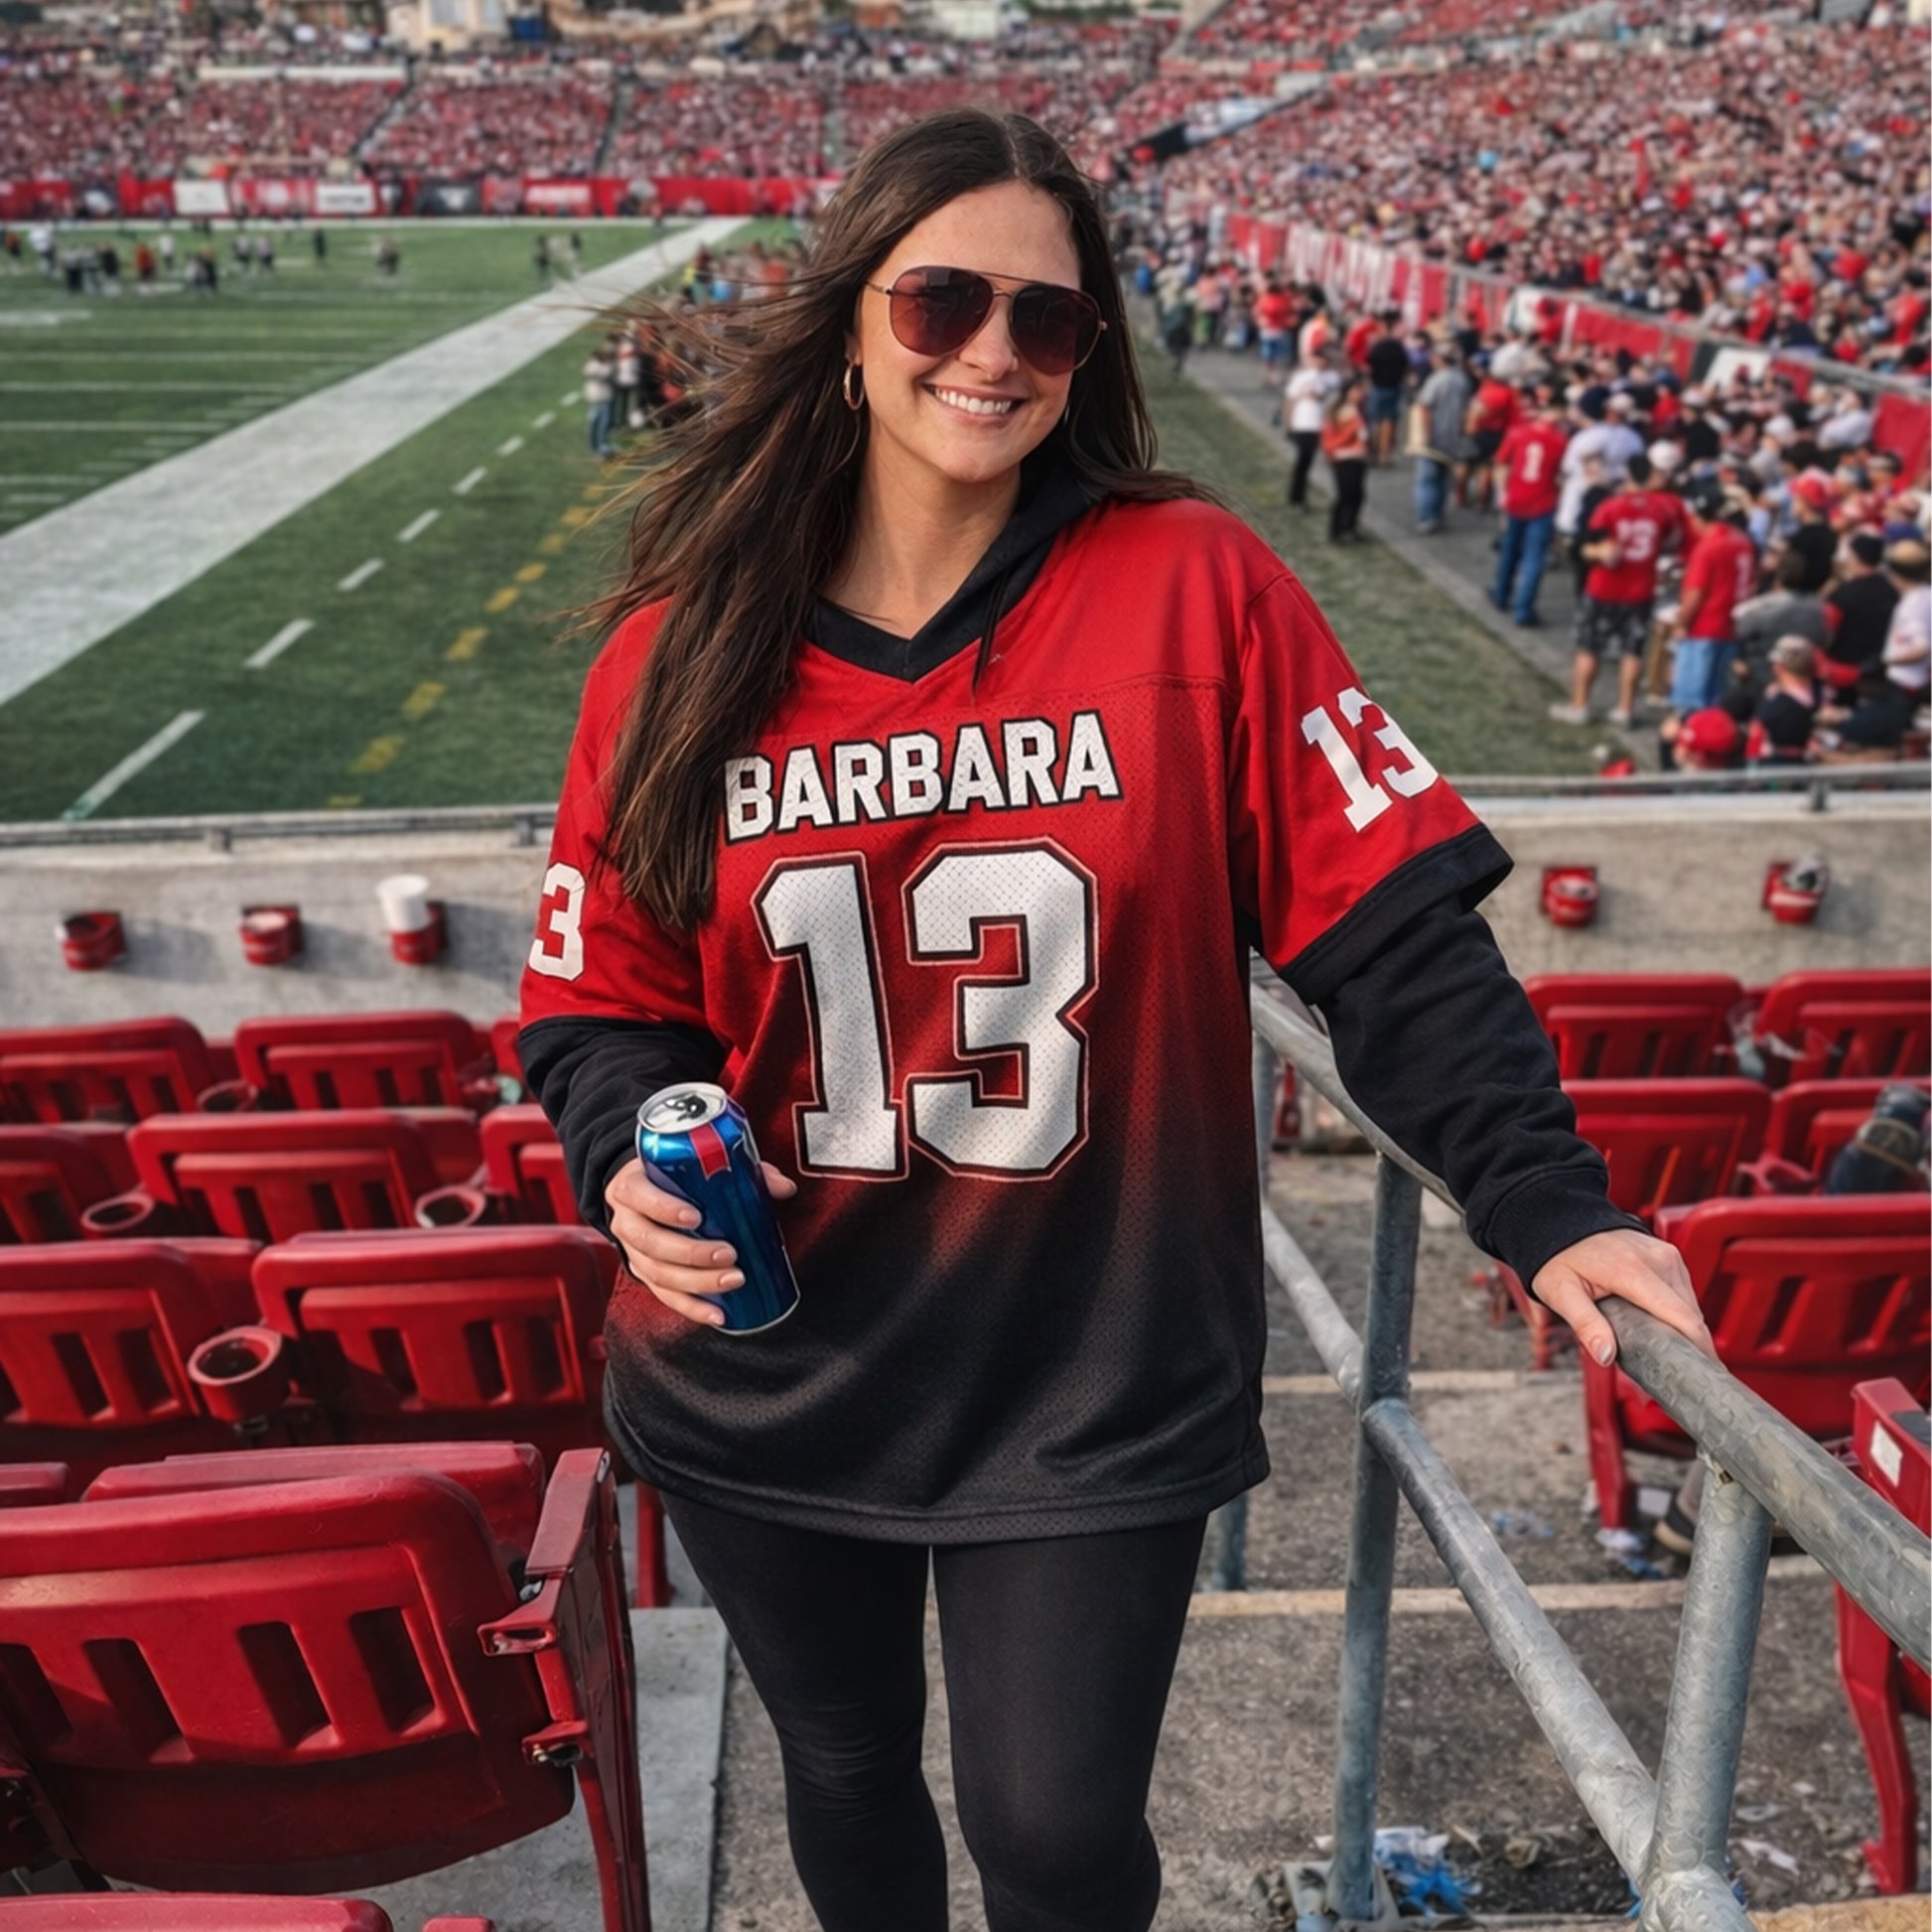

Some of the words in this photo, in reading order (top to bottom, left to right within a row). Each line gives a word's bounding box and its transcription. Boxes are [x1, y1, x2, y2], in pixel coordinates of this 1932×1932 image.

[723, 709, 1123, 845] BARBARA
[1301, 686, 1440, 833] 13
[752, 836, 1100, 1181] 13
